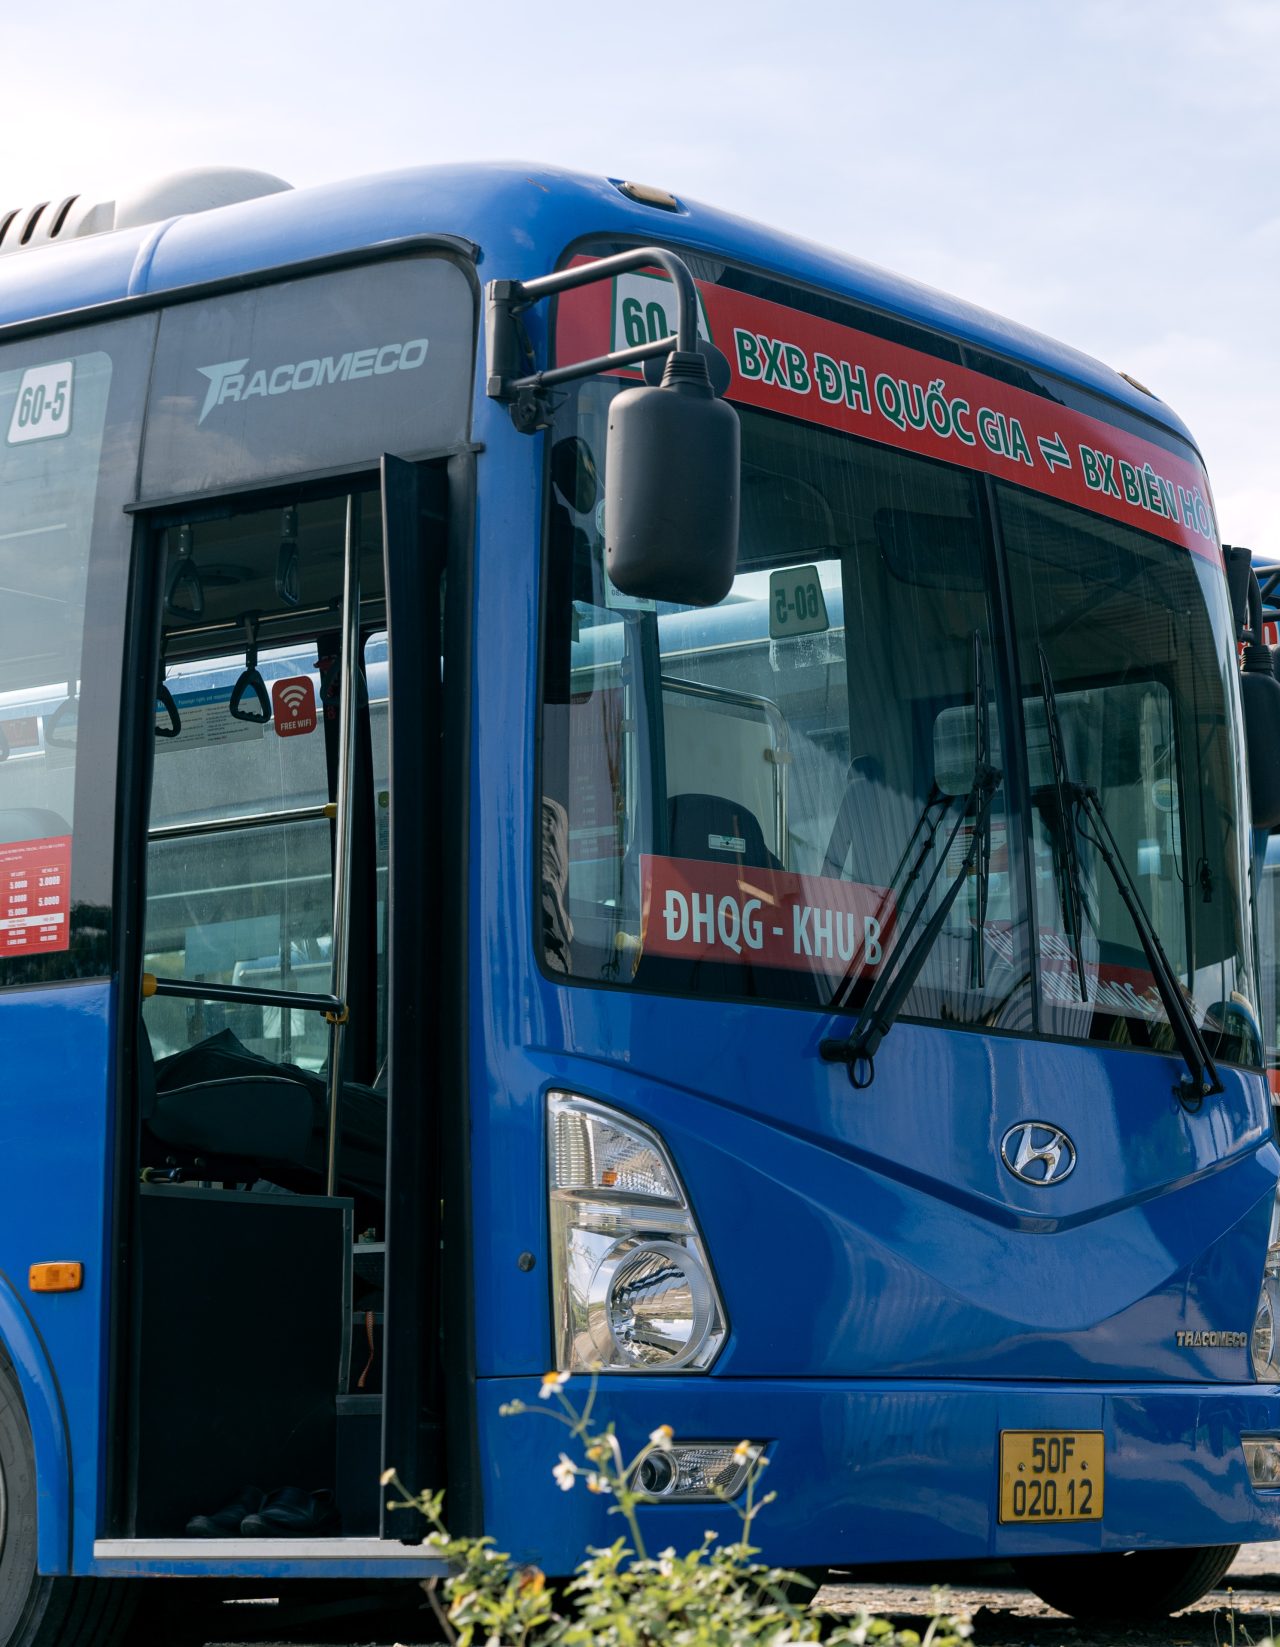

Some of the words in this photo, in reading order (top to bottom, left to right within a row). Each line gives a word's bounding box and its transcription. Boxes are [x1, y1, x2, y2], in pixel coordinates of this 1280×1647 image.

[196, 338, 429, 426] TRACOMECO
[18, 380, 67, 428] 60-5
[734, 328, 811, 394] BXB
[814, 353, 872, 414] ĐH
[874, 379, 977, 445] QUỐC
[977, 407, 1034, 467] GIA
[1078, 444, 1122, 499] BX
[1118, 462, 1180, 523] BIÊN
[280, 721, 296, 731] FREE
[297, 719, 312, 728] WIFI
[663, 889, 764, 955] ĐHQG
[793, 904, 855, 962] KHU
[864, 915, 883, 966] B
[1176, 1330, 1248, 1347] TRACOMECO
[1032, 1437, 1075, 1474] 50F
[1013, 1478, 1093, 1516] 020.12
